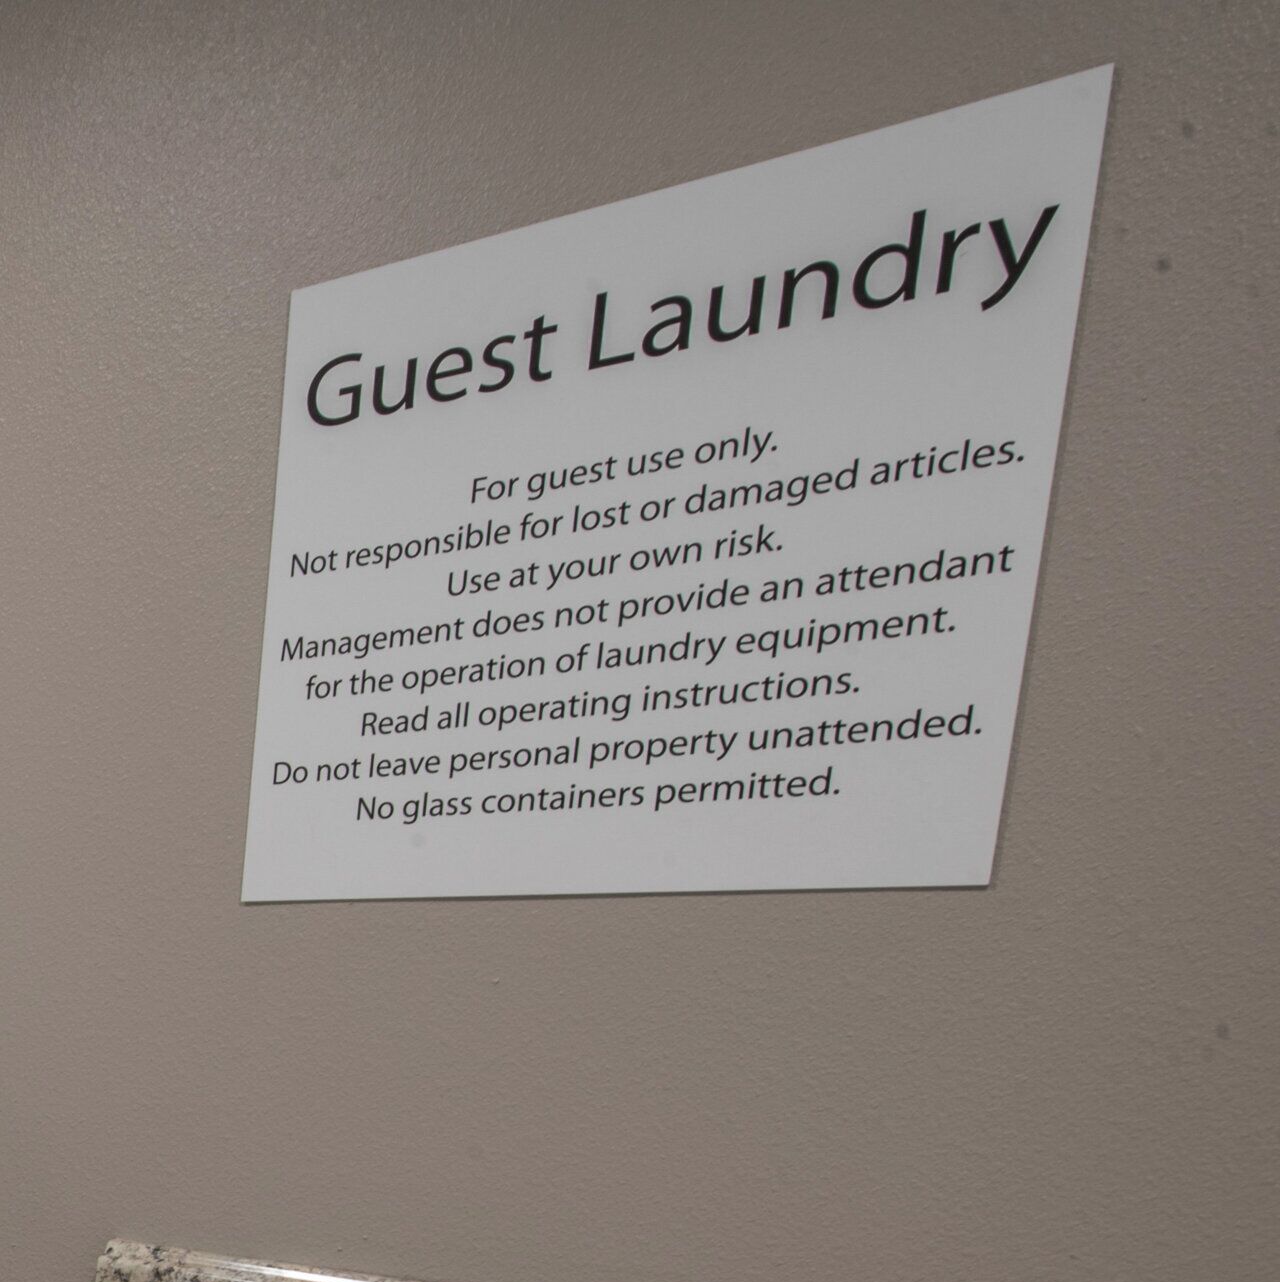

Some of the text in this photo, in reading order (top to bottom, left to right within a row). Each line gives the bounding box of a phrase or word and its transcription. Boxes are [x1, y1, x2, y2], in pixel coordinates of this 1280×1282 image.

[306, 203, 1060, 427] Guest Laundry
[471, 426, 778, 504] For guest use only.
[290, 438, 1025, 578] Not responsible for lost or damaged articles.
[447, 523, 783, 597] Use at your own risk.
[280, 545, 1015, 662] Management does not provide an attendant
[306, 607, 956, 700] for the operation of laundry equipment.
[272, 704, 982, 785] Do not leave personal property unattended.
[361, 671, 860, 737] Read all operating instructions.
[356, 765, 840, 825] No glass containers permitted.
